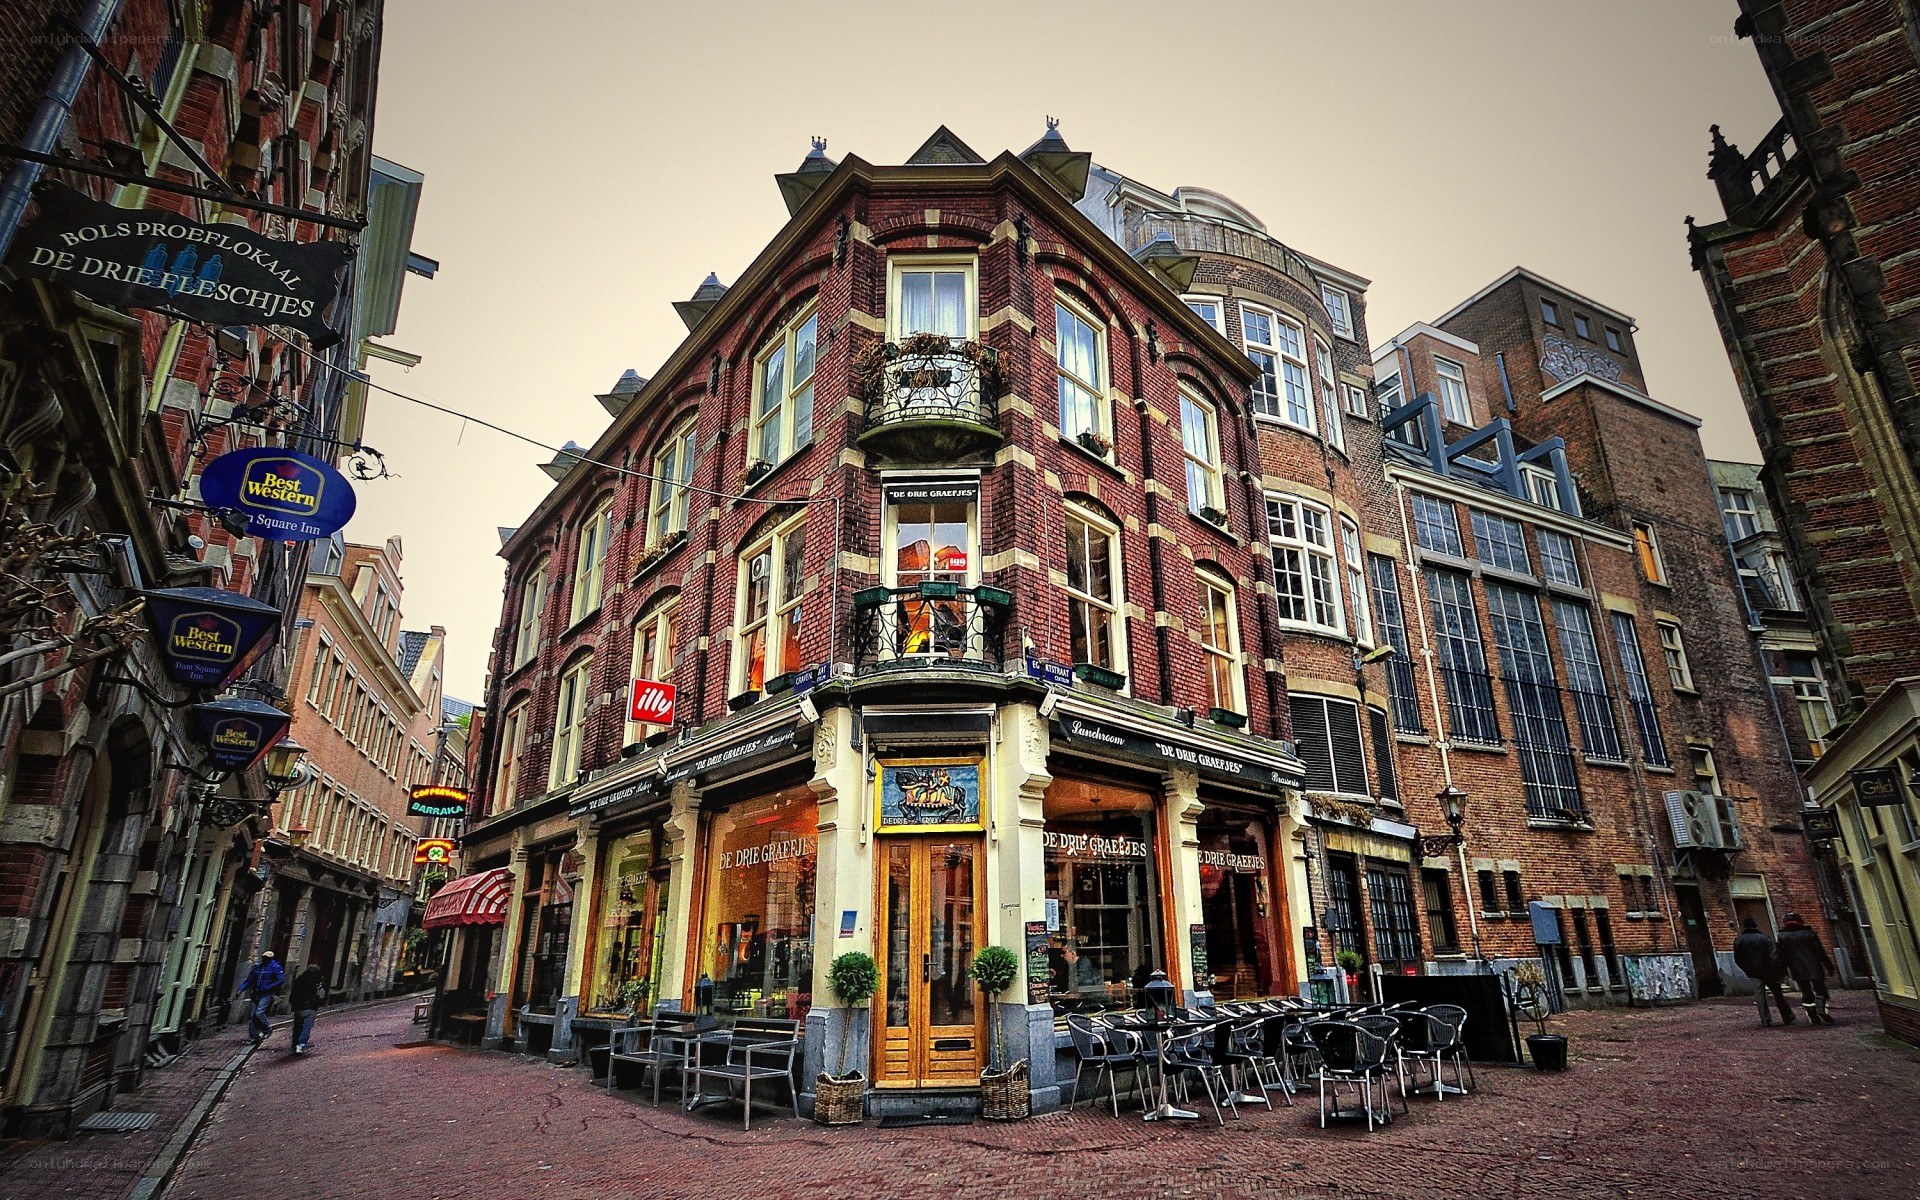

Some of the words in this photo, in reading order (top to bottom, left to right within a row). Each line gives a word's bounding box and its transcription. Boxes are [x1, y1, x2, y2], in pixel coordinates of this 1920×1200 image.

[60, 222, 131, 246] BOLS
[136, 222, 302, 291] PROEFLOKAAL
[30, 246, 75, 271] DE
[79, 256, 155, 287] DRIE
[160, 271, 315, 317] FLESCHJES
[264, 472, 301, 492] Best
[248, 480, 315, 507] Western
[256, 514, 298, 530] Square
[300, 521, 320, 535] Inn
[175, 635, 232, 654] Western
[189, 626, 220, 642] Best
[175, 661, 193, 670] Dam
[195, 664, 220, 674] Square
[190, 671, 203, 679] Inn
[637, 687, 673, 718] illy
[215, 735, 256, 746] Western
[226, 728, 247, 738] Best
[1071, 720, 1125, 745] Lunchroom
[1176, 748, 1198, 763] DRIE
[1271, 771, 1300, 788] Brasserie
[411, 802, 464, 816] BARRAKA
[719, 851, 733, 869] DE
[735, 846, 760, 868] DRIE
[761, 836, 816, 865] GRAEFJES
[1043, 831, 1057, 847] DE
[1060, 833, 1087, 856] DRIE
[1089, 836, 1146, 858] GRAEFJES
[1205, 850, 1226, 870] DRIE
[1226, 853, 1265, 873] GRAEFJES
